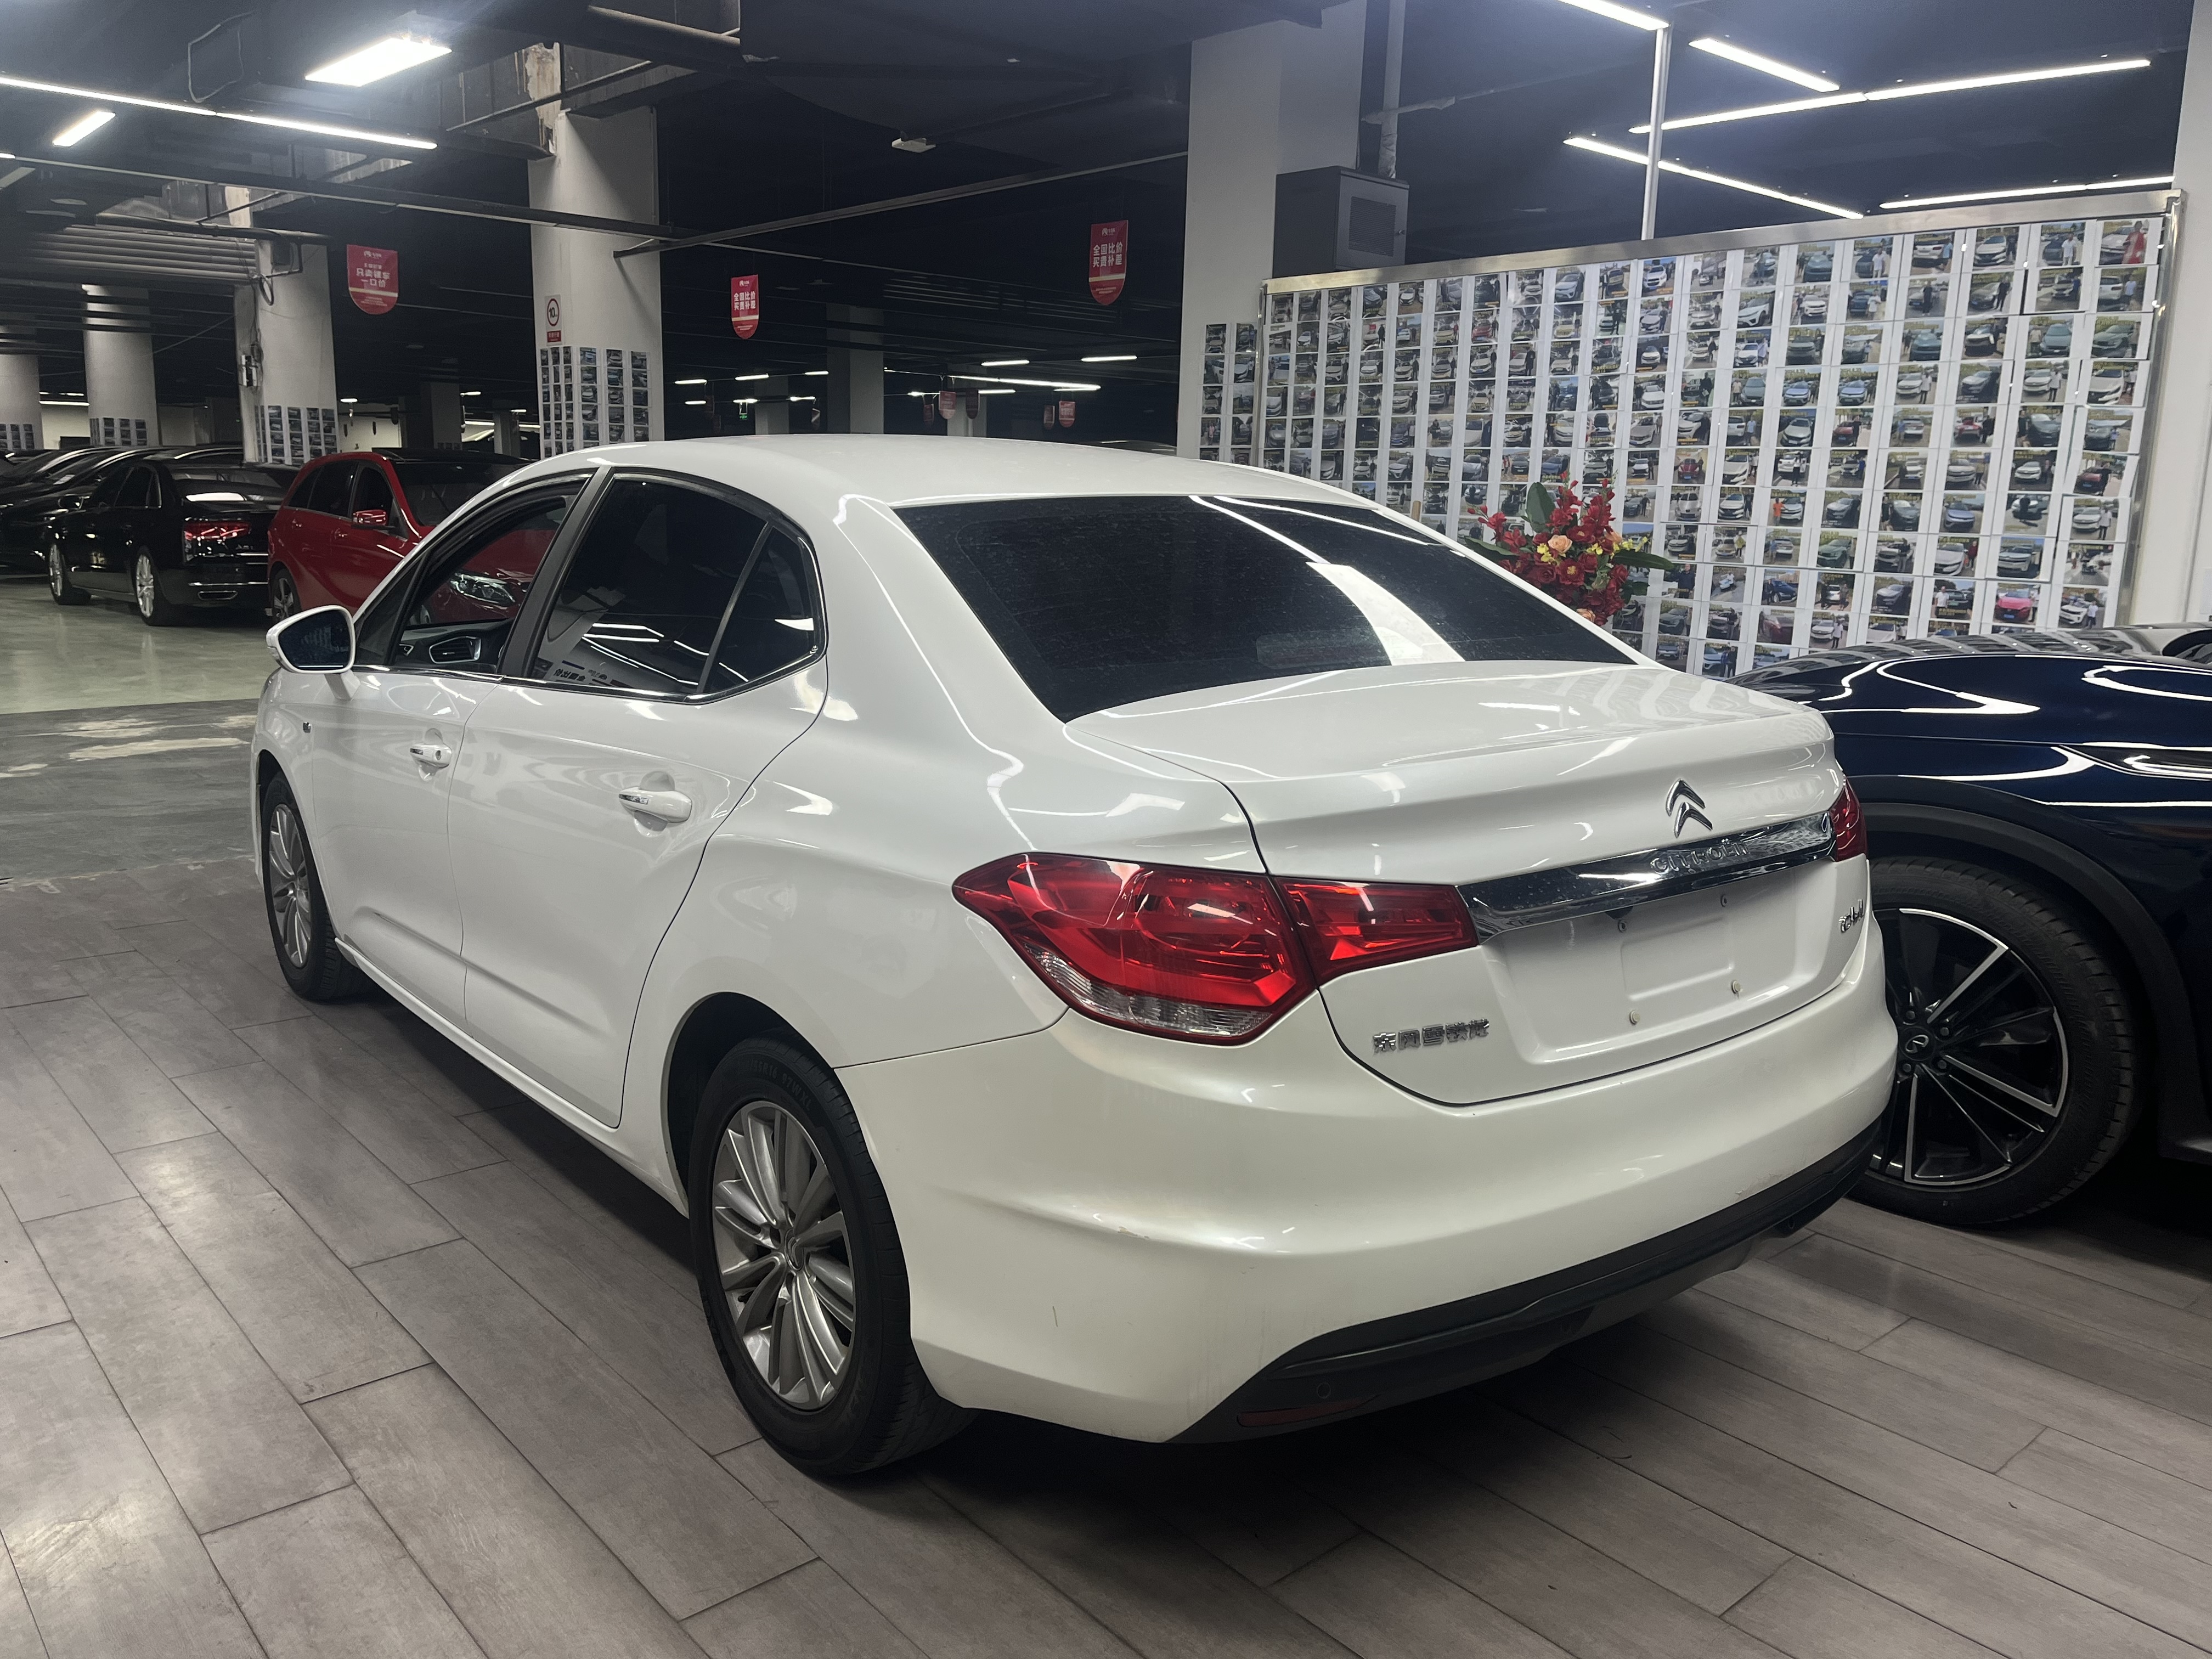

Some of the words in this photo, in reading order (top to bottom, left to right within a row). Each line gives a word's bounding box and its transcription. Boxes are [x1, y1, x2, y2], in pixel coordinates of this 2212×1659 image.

[1093, 241, 1123, 256] 全国比价
[1093, 254, 1122, 268] 买贵补差
[361, 279, 386, 287] 一口价
[733, 291, 756, 302] 全国比价
[549, 307, 555, 318] 10
[1650, 838, 1751, 875] CITROËN
